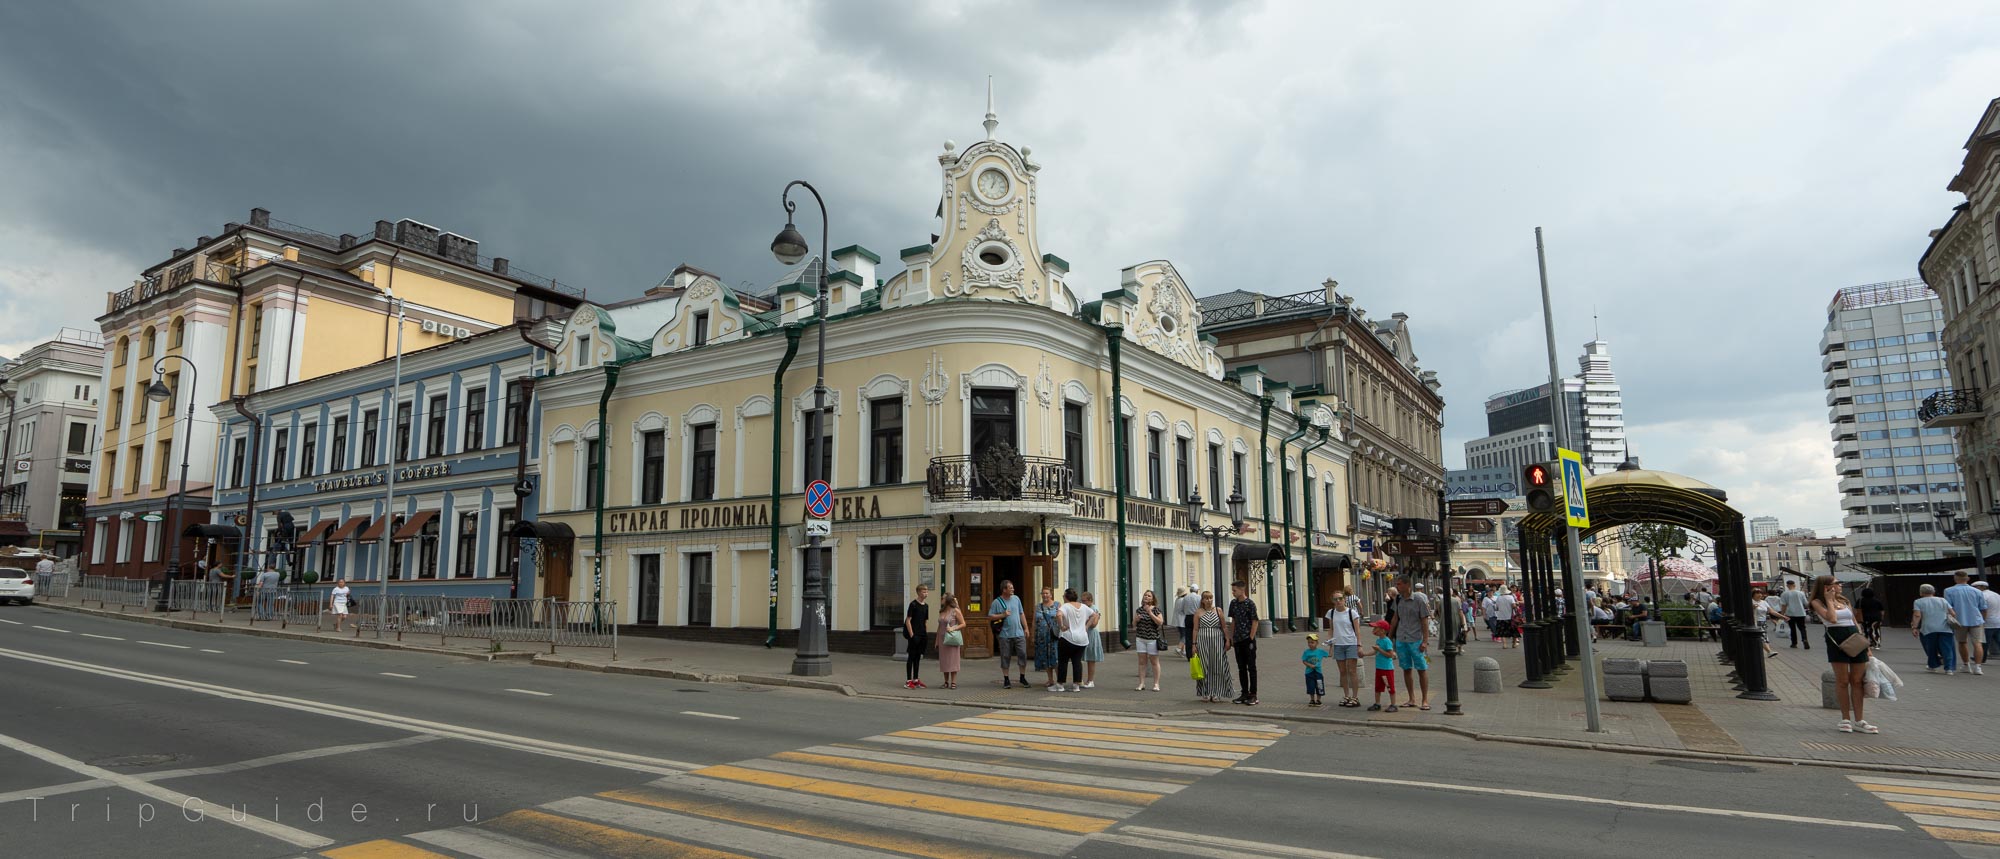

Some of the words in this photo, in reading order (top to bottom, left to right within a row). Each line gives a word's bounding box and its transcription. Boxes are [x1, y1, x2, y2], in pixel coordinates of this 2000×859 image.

[399, 464, 451, 480] COFFEE
[1445, 482, 1516, 496] ЛЬЦО
[1072, 493, 1105, 520] ТАРАЯ
[610, 509, 669, 532] СТАРАЯ
[680, 503, 769, 529] ПРОЛОМНА
